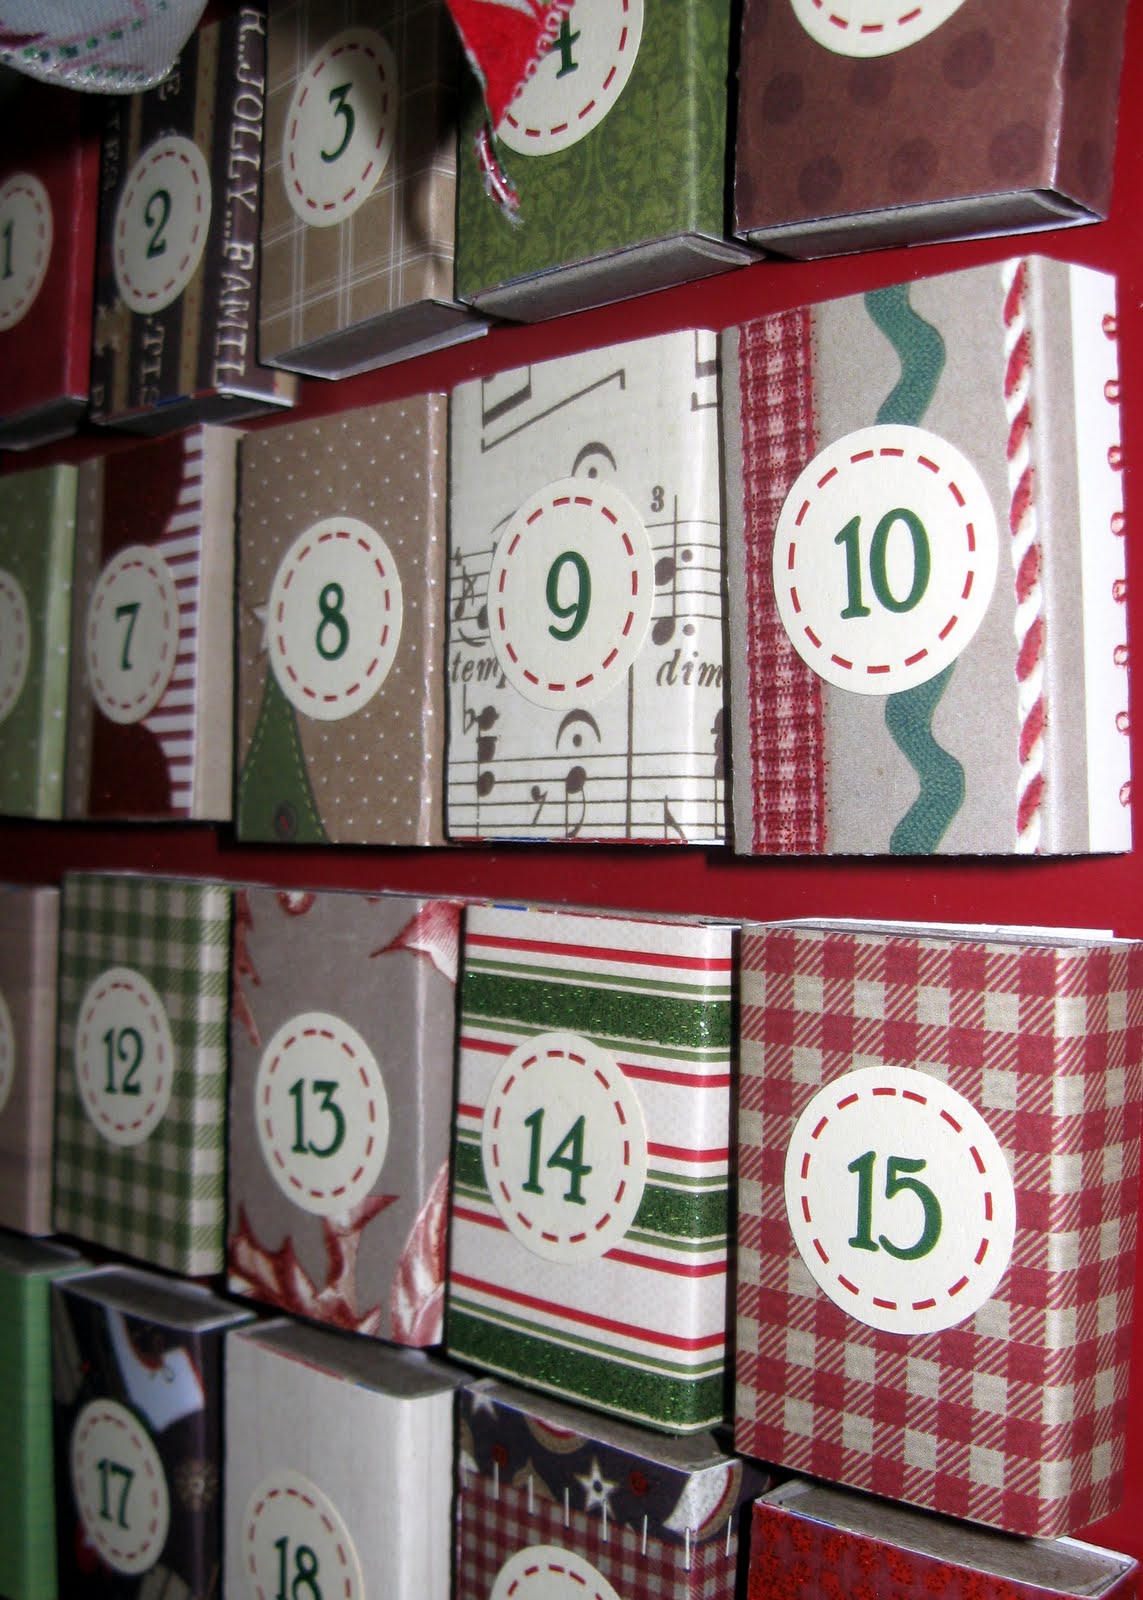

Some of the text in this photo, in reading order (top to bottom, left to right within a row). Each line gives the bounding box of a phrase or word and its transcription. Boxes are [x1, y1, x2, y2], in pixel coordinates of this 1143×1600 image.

[321, 80, 354, 163] 3
[2, 218, 14, 281] 1
[144, 189, 172, 260] 2
[650, 485, 666, 513] 3
[545, 550, 592, 643] 9
[835, 507, 931, 619] 10
[114, 601, 141, 671] 7
[315, 582, 350, 660] 8
[102, 1027, 143, 1096] 12
[288, 1078, 346, 1160] 13
[521, 1106, 593, 1206] 14
[847, 1150, 942, 1261] 15
[96, 1458, 135, 1529] 17
[274, 1535, 323, 1600] 18
